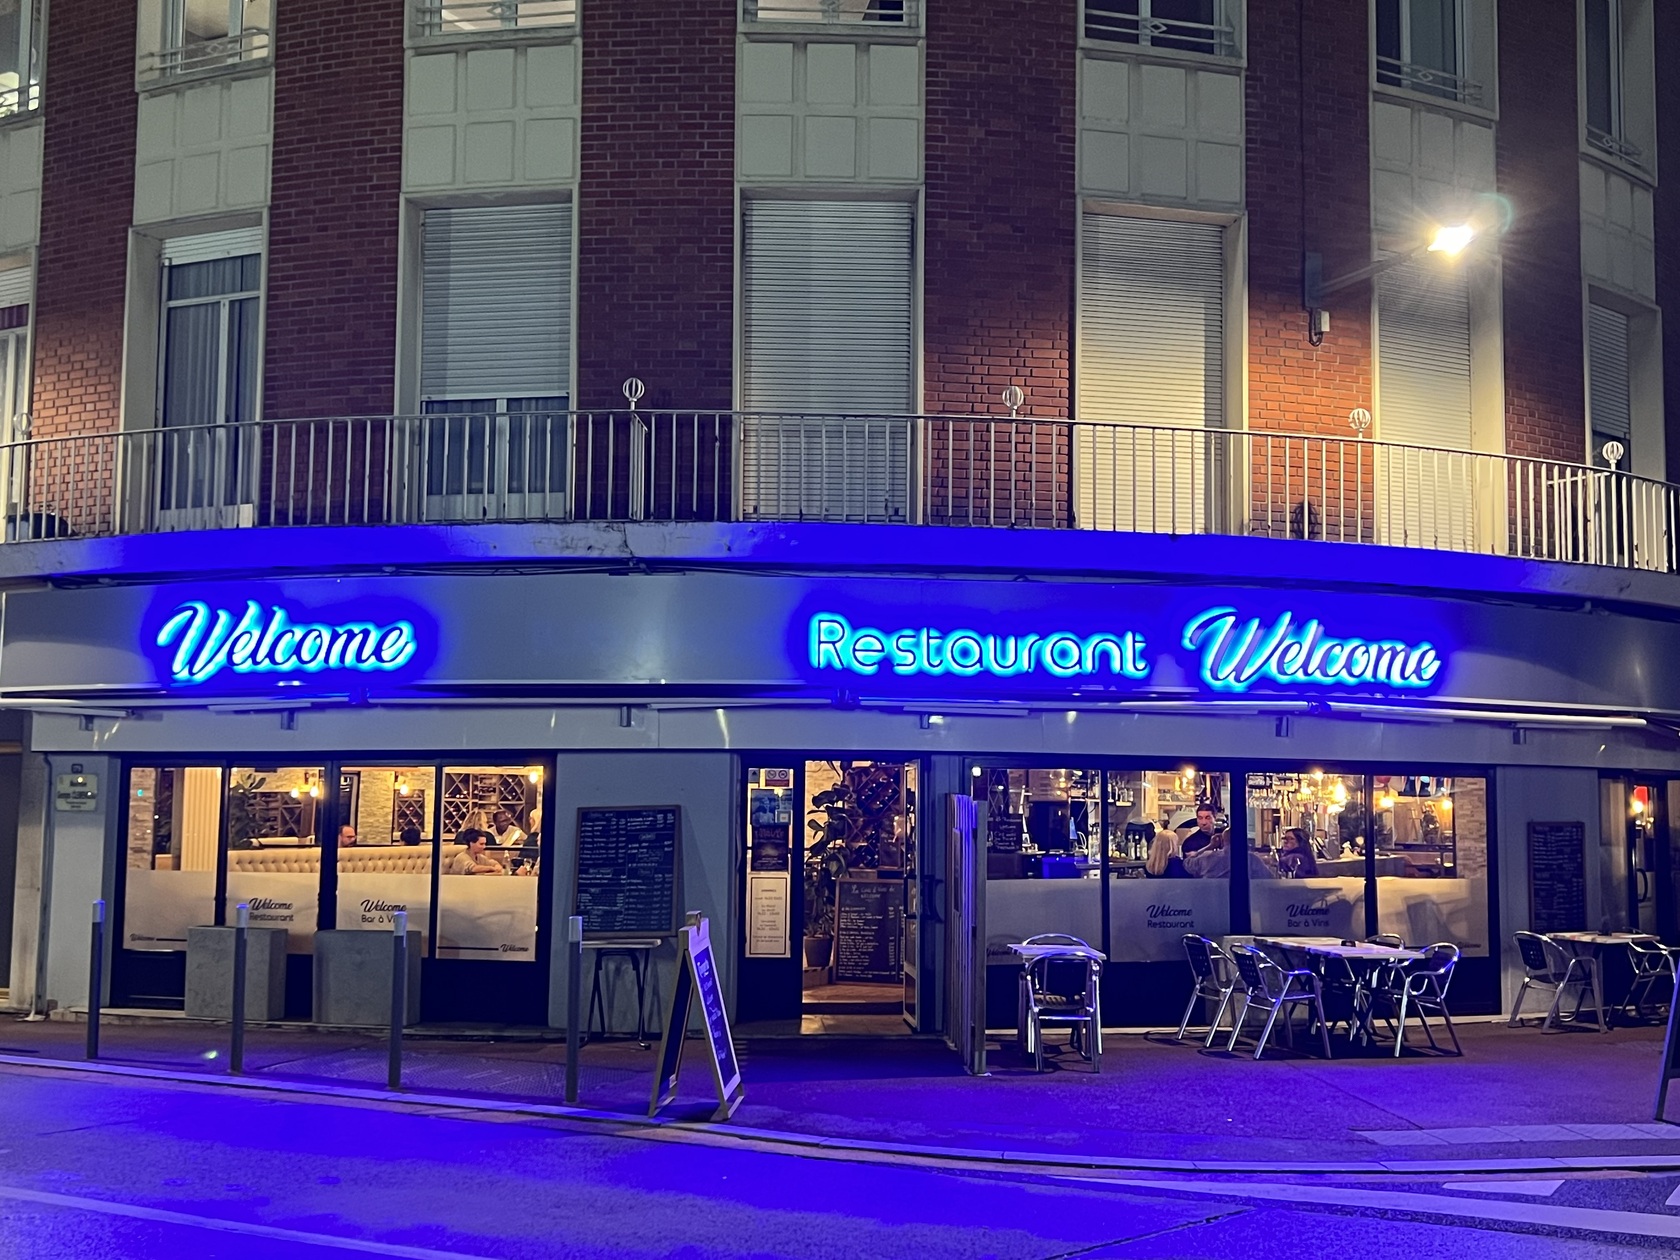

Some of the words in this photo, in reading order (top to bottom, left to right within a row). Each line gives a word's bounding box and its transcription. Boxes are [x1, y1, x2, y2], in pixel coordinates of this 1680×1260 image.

[156, 600, 416, 683] Welcome
[812, 614, 1149, 677] Restaurant
[1182, 607, 1441, 688] Welcome
[248, 898, 294, 911] Welcome
[360, 899, 407, 912] Welcome
[1146, 904, 1193, 918] Welcome
[1286, 904, 1330, 917] Welcome
[249, 912, 294, 922] Restaurant
[361, 914, 376, 923] Bar
[1287, 919, 1301, 928] Bar
[1312, 919, 1330, 927] Vins
[1147, 920, 1195, 929] Restaurant
